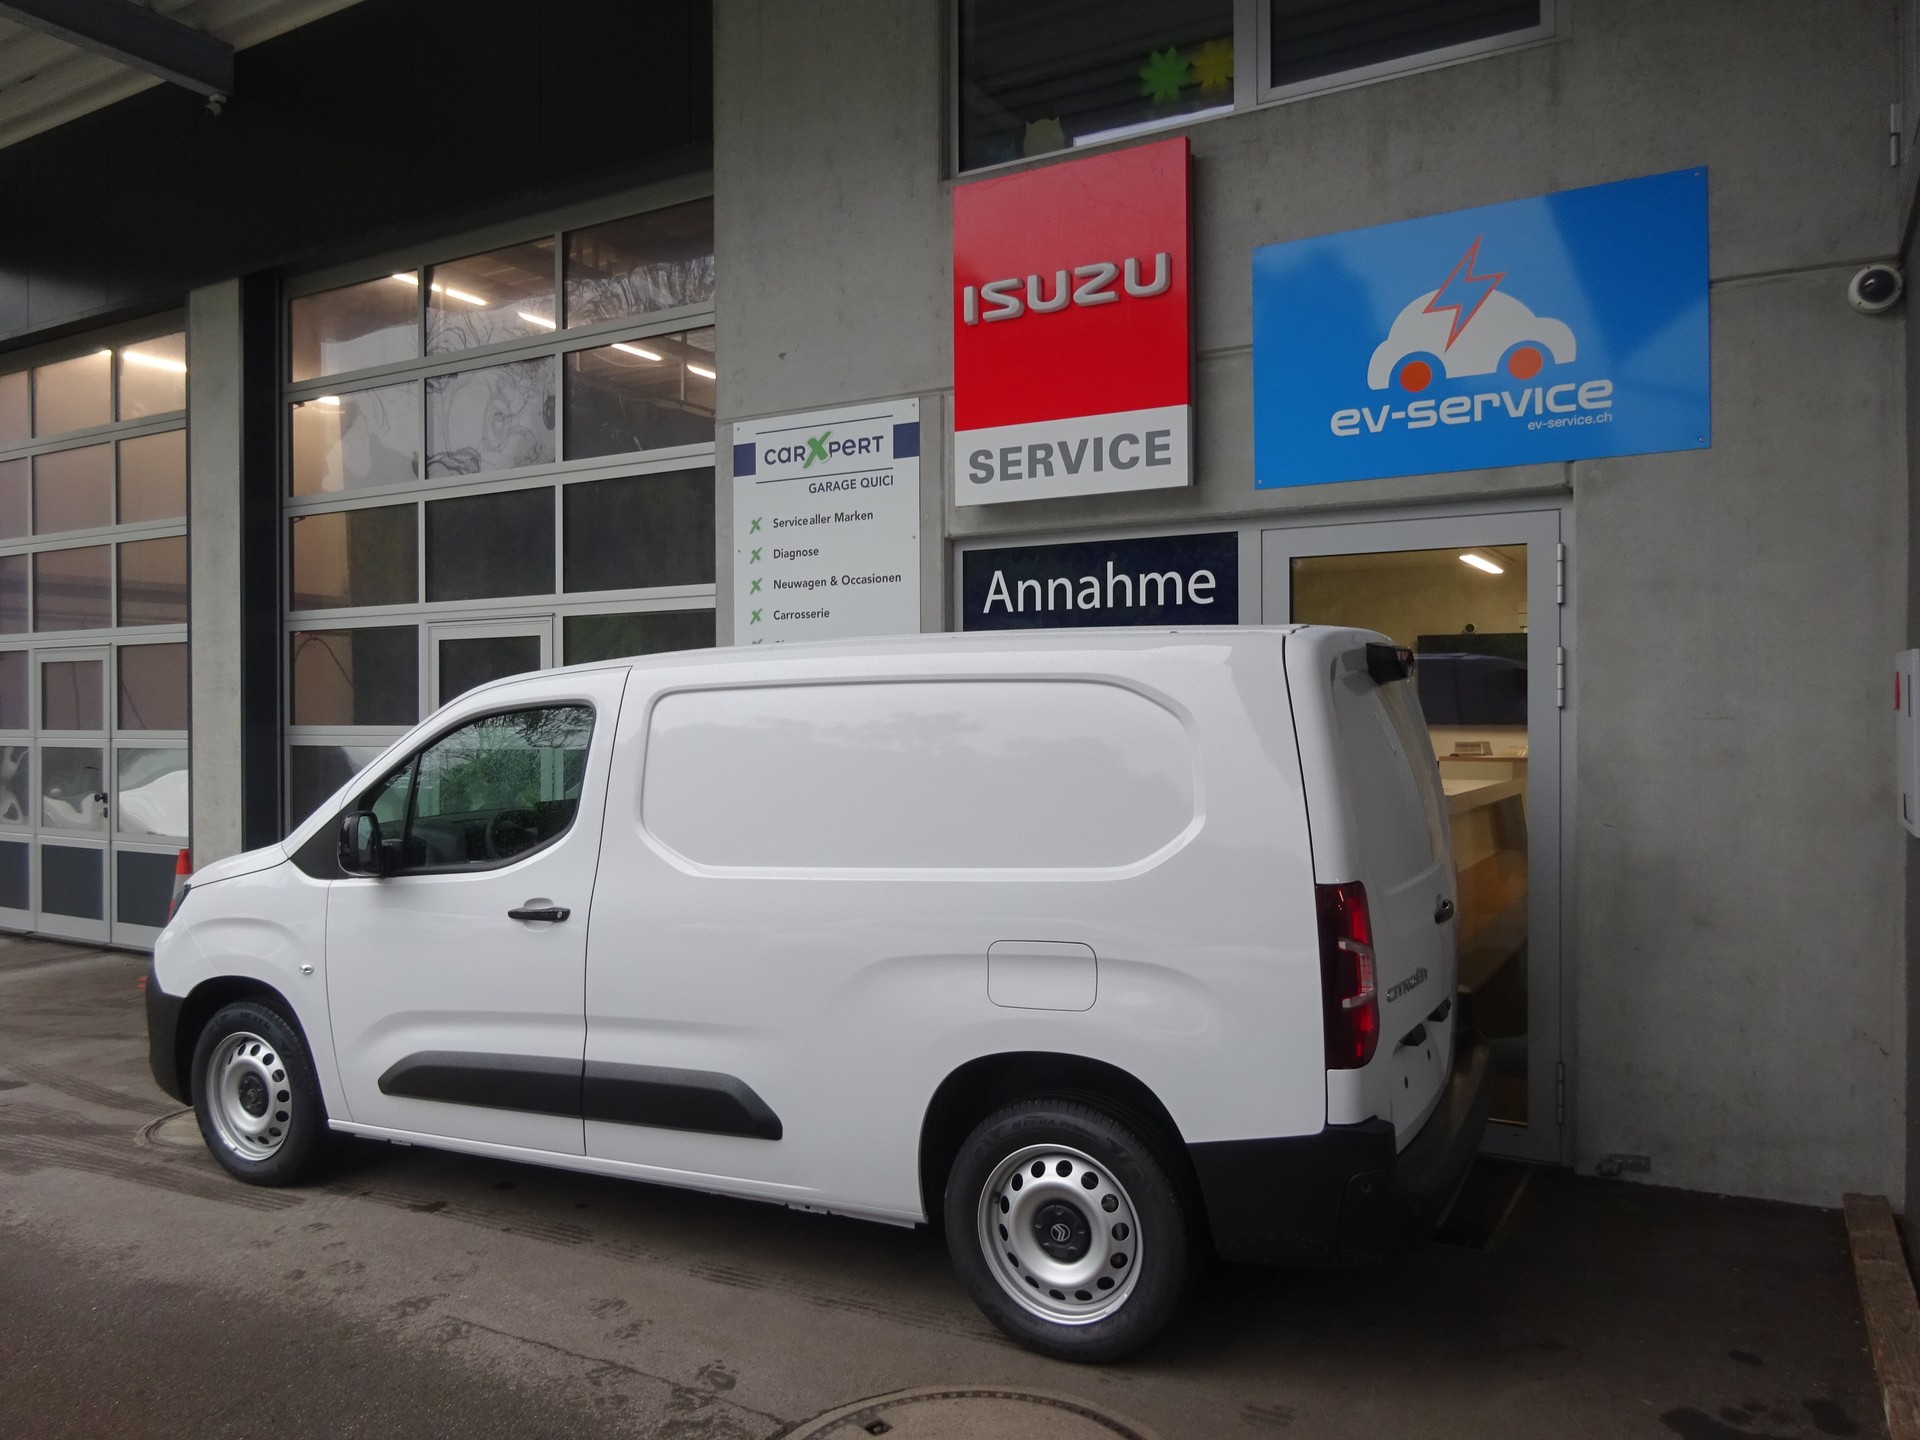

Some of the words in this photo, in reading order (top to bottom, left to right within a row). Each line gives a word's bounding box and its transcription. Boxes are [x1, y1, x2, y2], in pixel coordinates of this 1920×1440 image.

[963, 252, 1171, 326] ISUZU
[1330, 379, 1614, 437] ev-service
[1527, 411, 1613, 431] ev-service.ch
[968, 429, 1171, 485] SERVICE
[808, 478, 857, 494] GARAGE
[860, 475, 894, 489] QUICI
[773, 518, 809, 529] Service
[809, 514, 832, 526] aller
[834, 510, 874, 523] Marken
[773, 547, 819, 561] Diagnose
[773, 577, 827, 591] Neuwagen
[829, 576, 839, 587] &
[841, 573, 902, 586] Occasionen
[983, 561, 1216, 614] Annahme
[773, 609, 830, 621] Carrosserie
